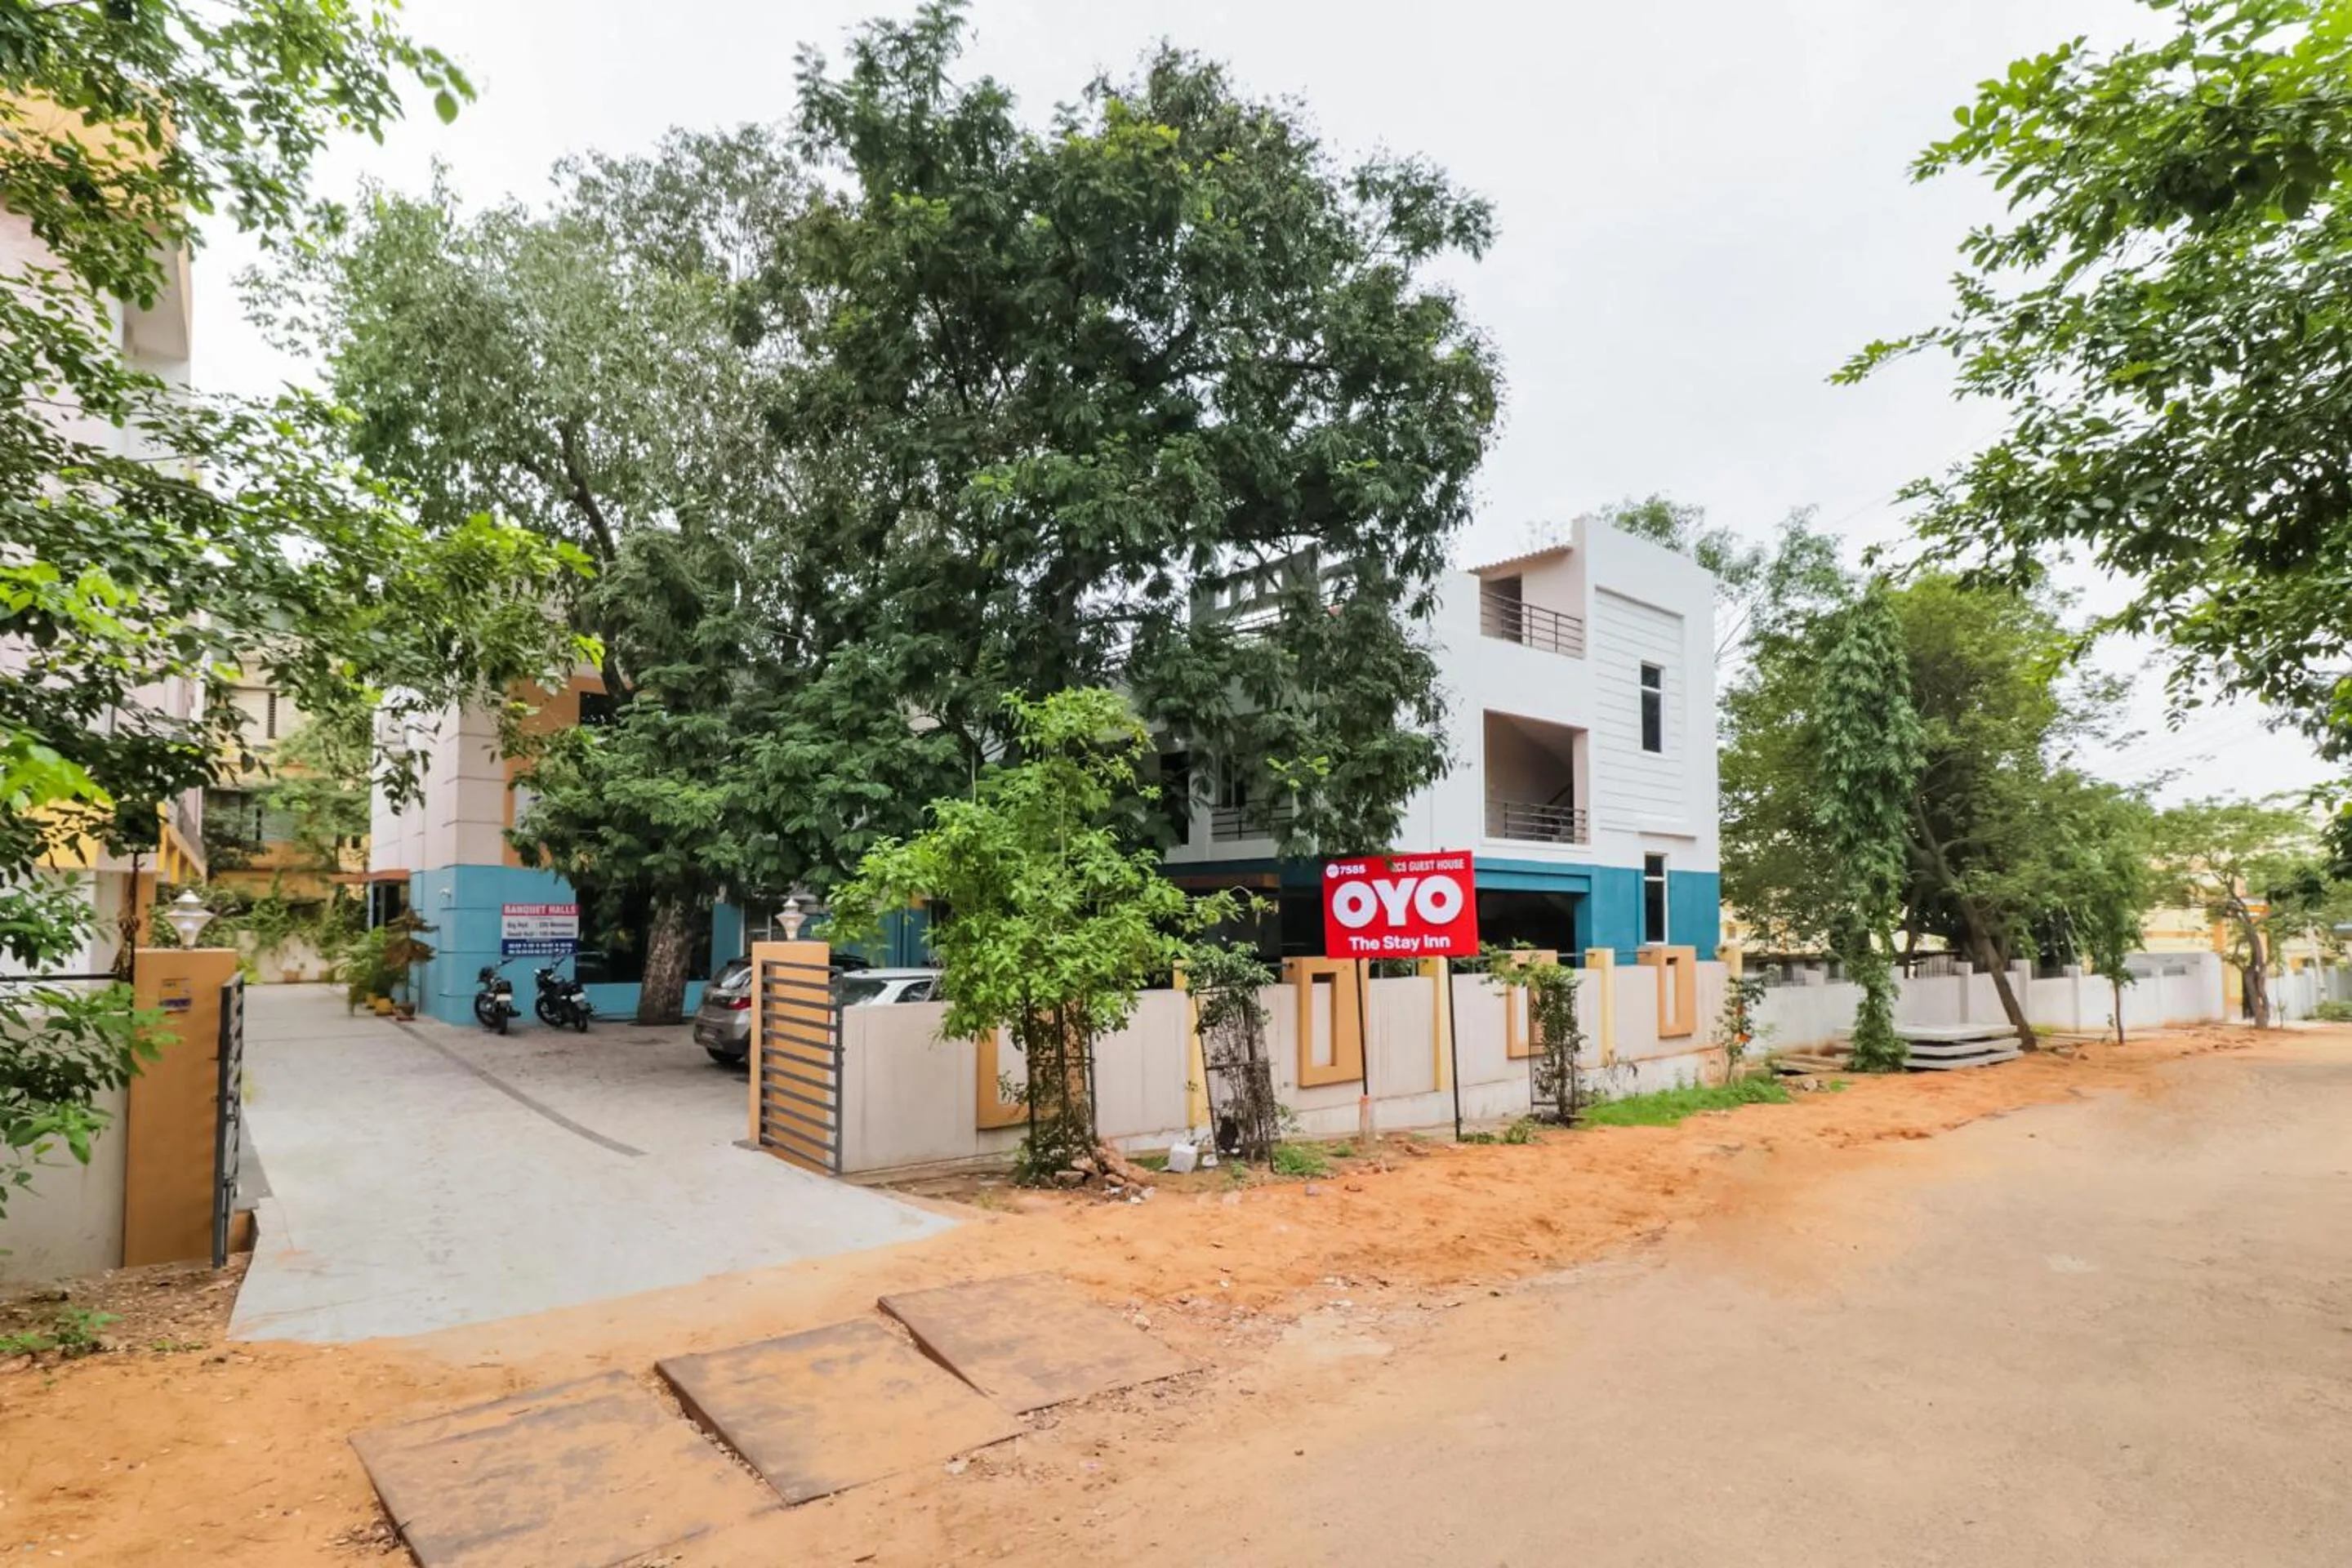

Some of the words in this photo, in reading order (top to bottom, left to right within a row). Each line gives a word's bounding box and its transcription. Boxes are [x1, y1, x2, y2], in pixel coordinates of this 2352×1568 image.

[1339, 864, 1366, 875] 7585
[1409, 860, 1435, 871] GUEST
[1437, 858, 1464, 870] HOUSE
[1333, 875, 1464, 929] OYO
[505, 904, 546, 914] BANQUET
[548, 904, 576, 913] HALLS
[1348, 937, 1380, 951] The
[1383, 935, 1420, 951] Stay
[1424, 934, 1450, 947] Inn
